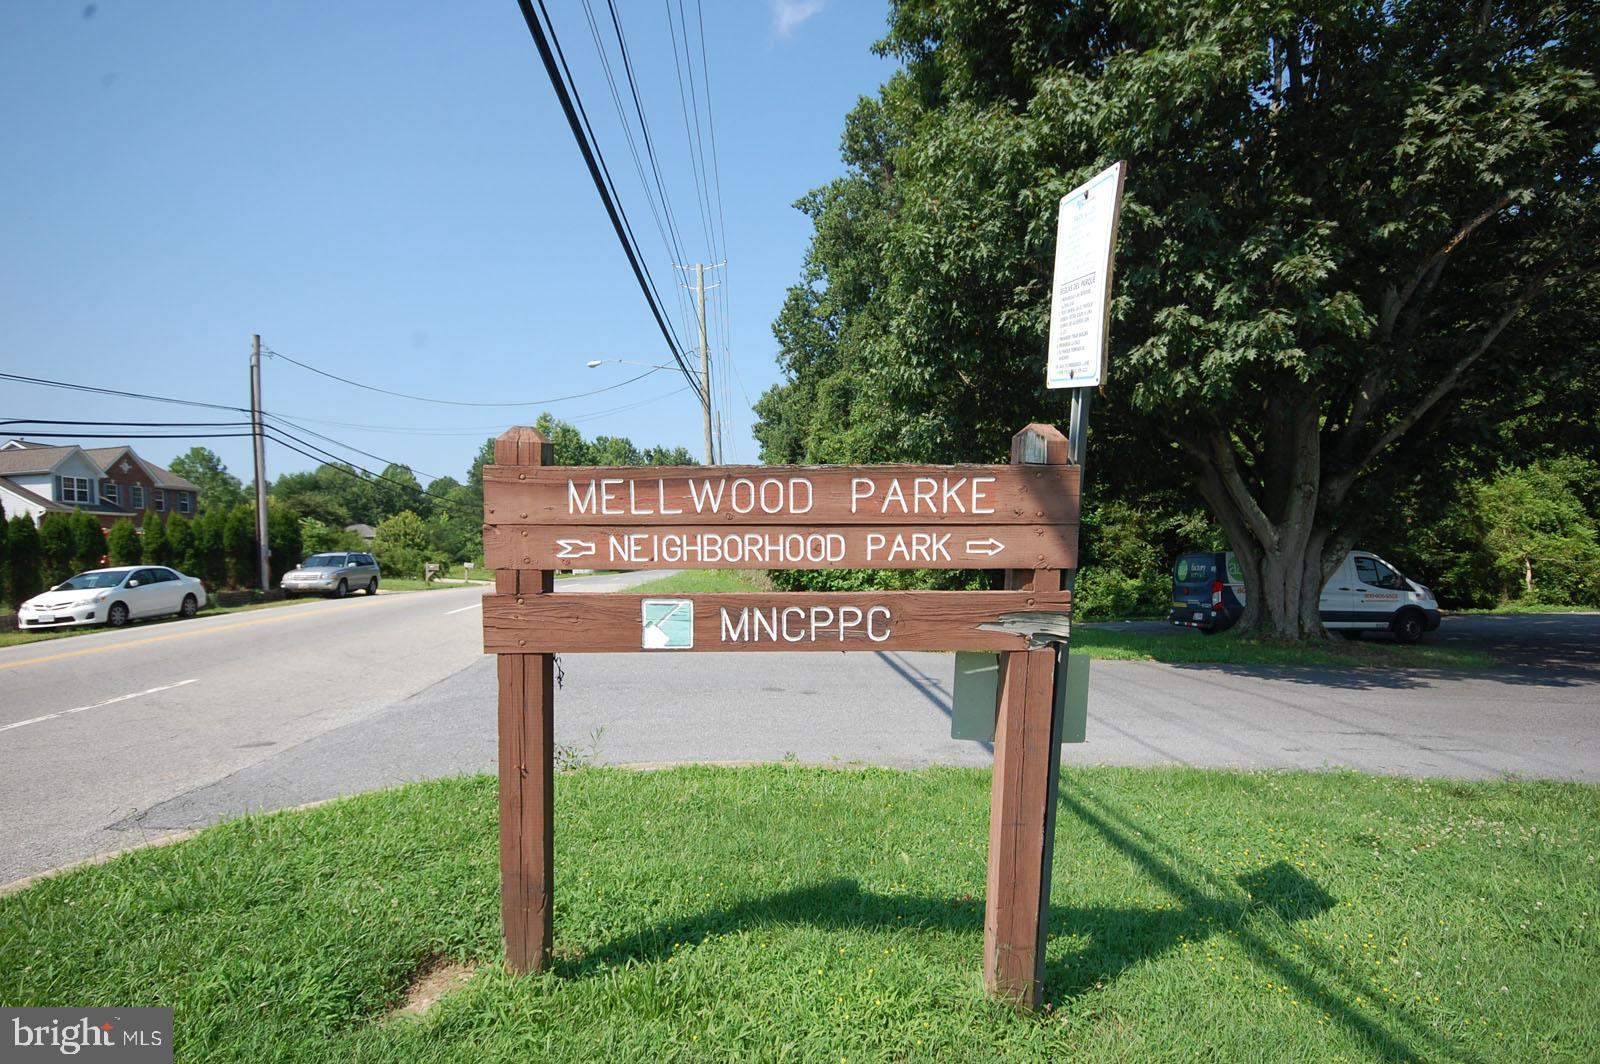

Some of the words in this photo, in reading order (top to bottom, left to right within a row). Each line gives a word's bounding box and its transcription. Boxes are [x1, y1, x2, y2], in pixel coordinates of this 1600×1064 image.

[568, 478, 812, 515] MELLWOOD
[852, 478, 995, 513] PARKE
[609, 534, 845, 562] NEIGHBORHOOD
[867, 533, 951, 561] PARK
[721, 606, 890, 641] MNCPPC
